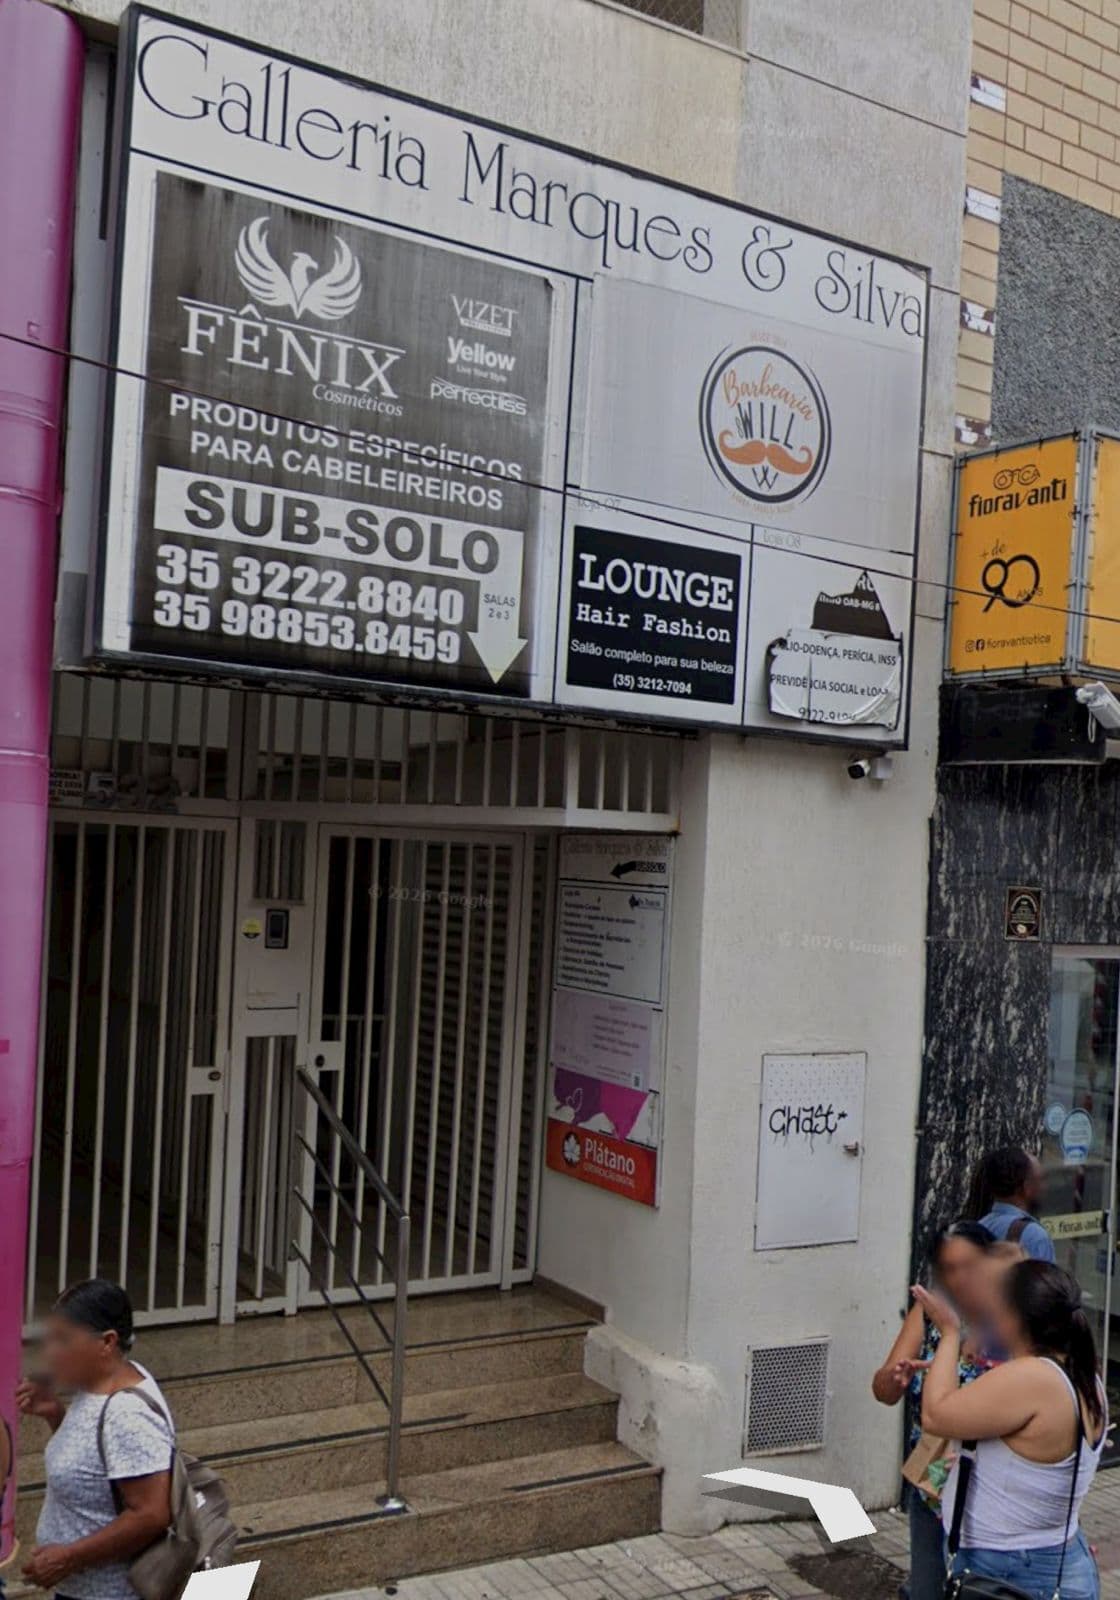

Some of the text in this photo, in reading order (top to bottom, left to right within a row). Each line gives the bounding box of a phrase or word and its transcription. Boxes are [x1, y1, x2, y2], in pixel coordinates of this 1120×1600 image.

[137, 35, 925, 337] Galleria Marques & Silva
[450, 293, 519, 330] VIZET
[180, 303, 401, 399] FÊNIX
[312, 384, 404, 417] Cosméticos
[430, 382, 528, 416] perfectliss
[723, 363, 815, 422] Barbearia
[170, 393, 523, 481] PRODUTOS ESPECÍFICOS
[737, 400, 795, 449] WILL
[190, 430, 504, 511] PARA CABELEIREIROS
[968, 478, 1067, 518] fioravanti
[184, 479, 500, 575] SUB-SOLO
[156, 543, 465, 626] 35 3222.8840
[484, 592, 516, 608] SALAS
[577, 552, 734, 612] LOUNGE
[981, 554, 1041, 613] 90
[153, 589, 461, 664] 35 98853.8459
[576, 602, 732, 643] Hair Fashion
[570, 638, 734, 675] Salão completo para sua beleza
[877, 655, 896, 667] INSS
[612, 673, 692, 695] (35) 3212-7094
[770, 673, 827, 690] PREVIDÊCIA
[829, 681, 859, 696] SOCIAL
[584, 1136, 636, 1176] Plátano
